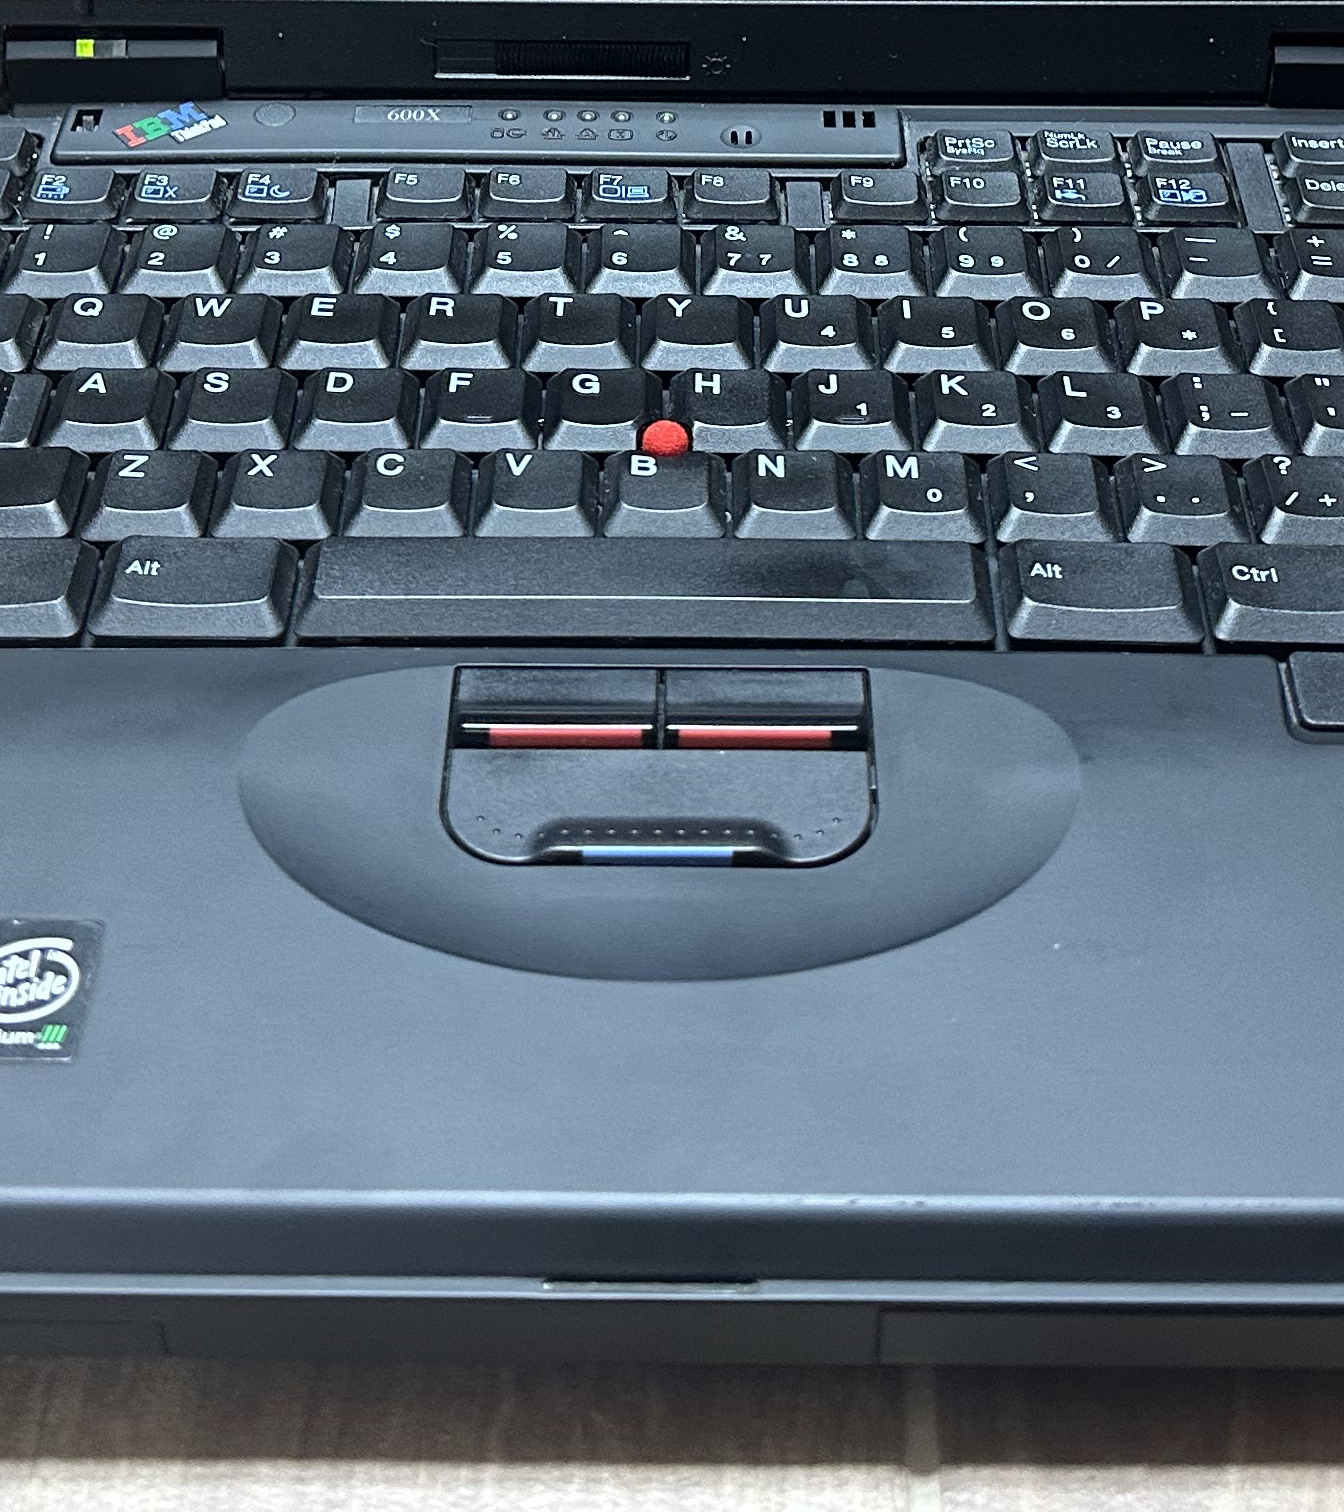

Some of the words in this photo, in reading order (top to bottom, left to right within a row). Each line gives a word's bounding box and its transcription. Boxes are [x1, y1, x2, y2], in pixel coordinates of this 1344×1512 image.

[115, 101, 207, 147] IBM
[387, 108, 441, 122] 600X
[944, 137, 995, 148] PrtSc
[1046, 139, 1098, 149] ScrLk
[1145, 138, 1203, 150] Pause
[41, 174, 66, 185] F2
[145, 174, 169, 186] F3
[247, 174, 271, 186] F4
[394, 174, 418, 186] F5
[497, 174, 520, 186] F6
[598, 174, 623, 186] F7
[701, 175, 724, 187] F8
[850, 175, 874, 188] F9
[949, 177, 985, 189] F10
[1052, 177, 1086, 190] F11
[1156, 178, 1191, 189] F12
[34, 252, 46, 265] 1
[148, 252, 164, 265] 2
[264, 251, 281, 265] 3
[379, 252, 396, 265] 4
[497, 252, 512, 265] 5
[612, 252, 628, 265] 6
[727, 253, 741, 266] 7
[843, 254, 859, 267] 8
[958, 255, 975, 268] 9
[73, 298, 103, 317] Q
[195, 297, 232, 318] W
[311, 297, 337, 317] E
[429, 297, 454, 317] R
[549, 297, 574, 317] T
[667, 298, 693, 317] Y
[785, 298, 809, 318] U
[1022, 301, 1051, 321] O
[1140, 301, 1164, 321] P
[79, 373, 107, 394] A
[204, 372, 231, 393] S
[326, 372, 353, 393] D
[448, 372, 474, 393] F
[571, 373, 600, 395] G
[694, 373, 721, 395] H
[818, 374, 838, 395] J
[940, 374, 969, 396] K
[1063, 375, 1088, 398] L
[118, 454, 146, 478] Z
[248, 454, 277, 477] X
[376, 454, 404, 476] C
[505, 453, 533, 476] V
[630, 455, 657, 477] B
[757, 455, 785, 478] N
[885, 455, 919, 479] M
[125, 560, 161, 576] Alt
[1030, 562, 1063, 579] Alt
[1232, 565, 1279, 583] Ctrl
